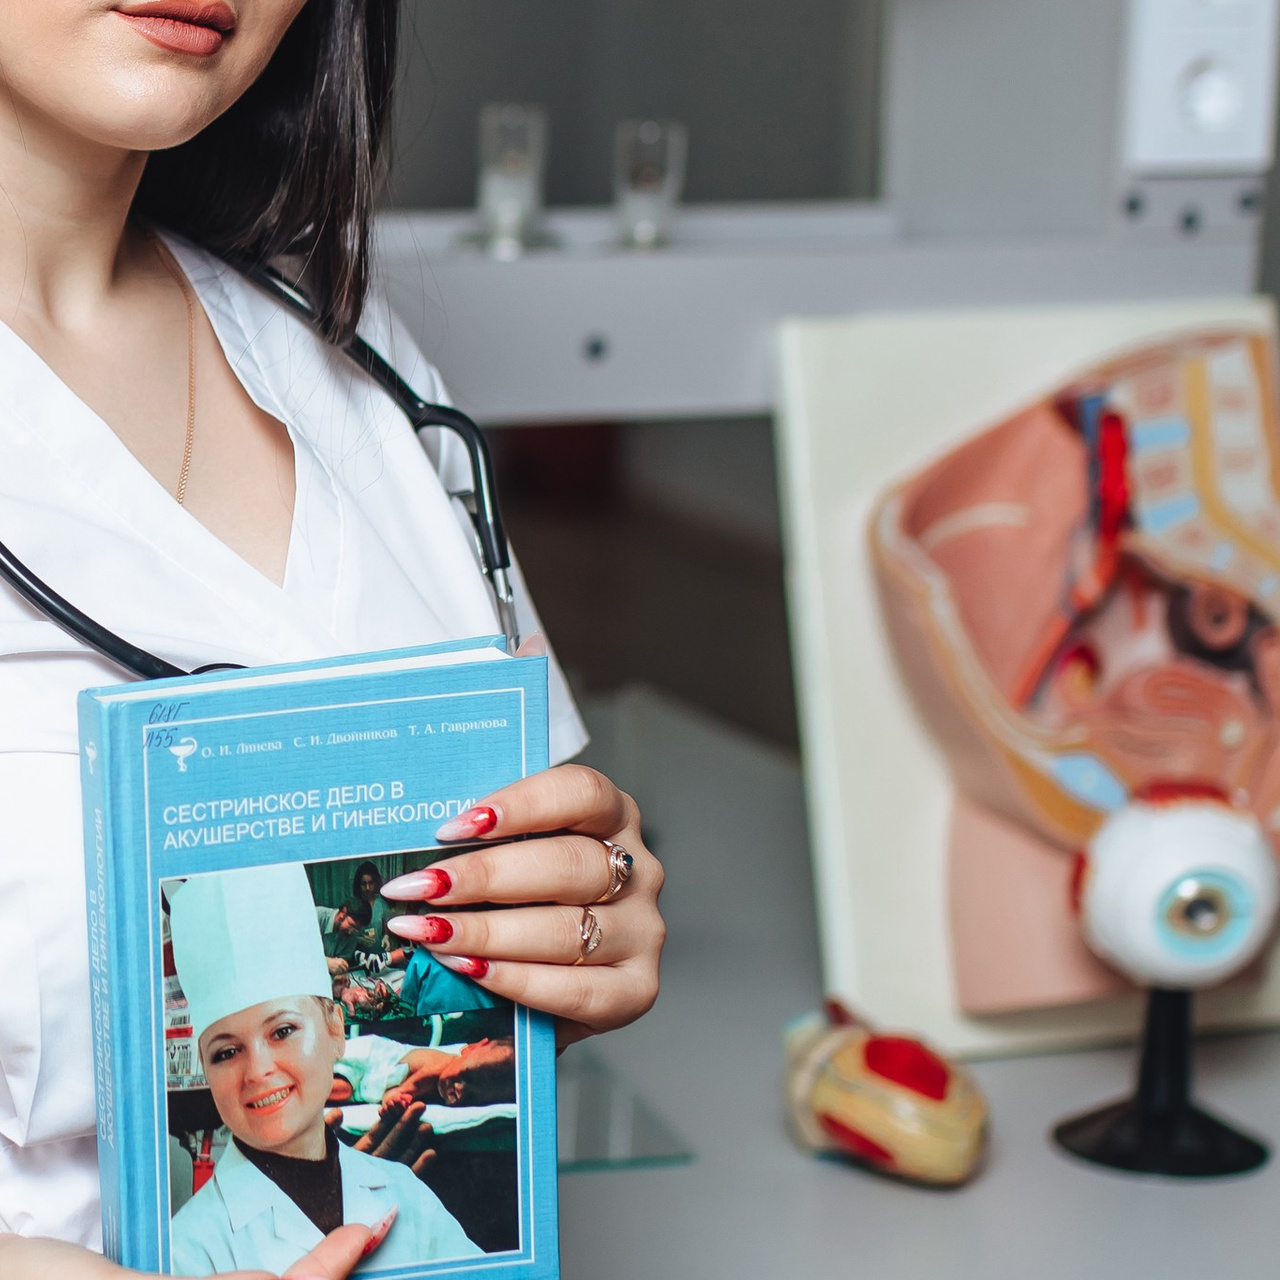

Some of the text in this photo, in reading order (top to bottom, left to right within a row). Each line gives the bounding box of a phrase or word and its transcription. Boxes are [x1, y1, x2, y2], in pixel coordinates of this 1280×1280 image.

[201, 718, 508, 758] О. И. Линева С. И. Двойников Т. А. Гаврилова
[163, 781, 404, 826] СЕСТРИНСКОЕ ДЕЛО В
[163, 797, 477, 851] АКУШЕРСТВЕ И ГИНЕКОЛОГИ
[94, 807, 115, 1150] АКУШЕРСТВЕ И ГИНЕКОЛОГИИ
[89, 889, 107, 1140] СЕСТРИНСКОЕ ДЕЛО В
